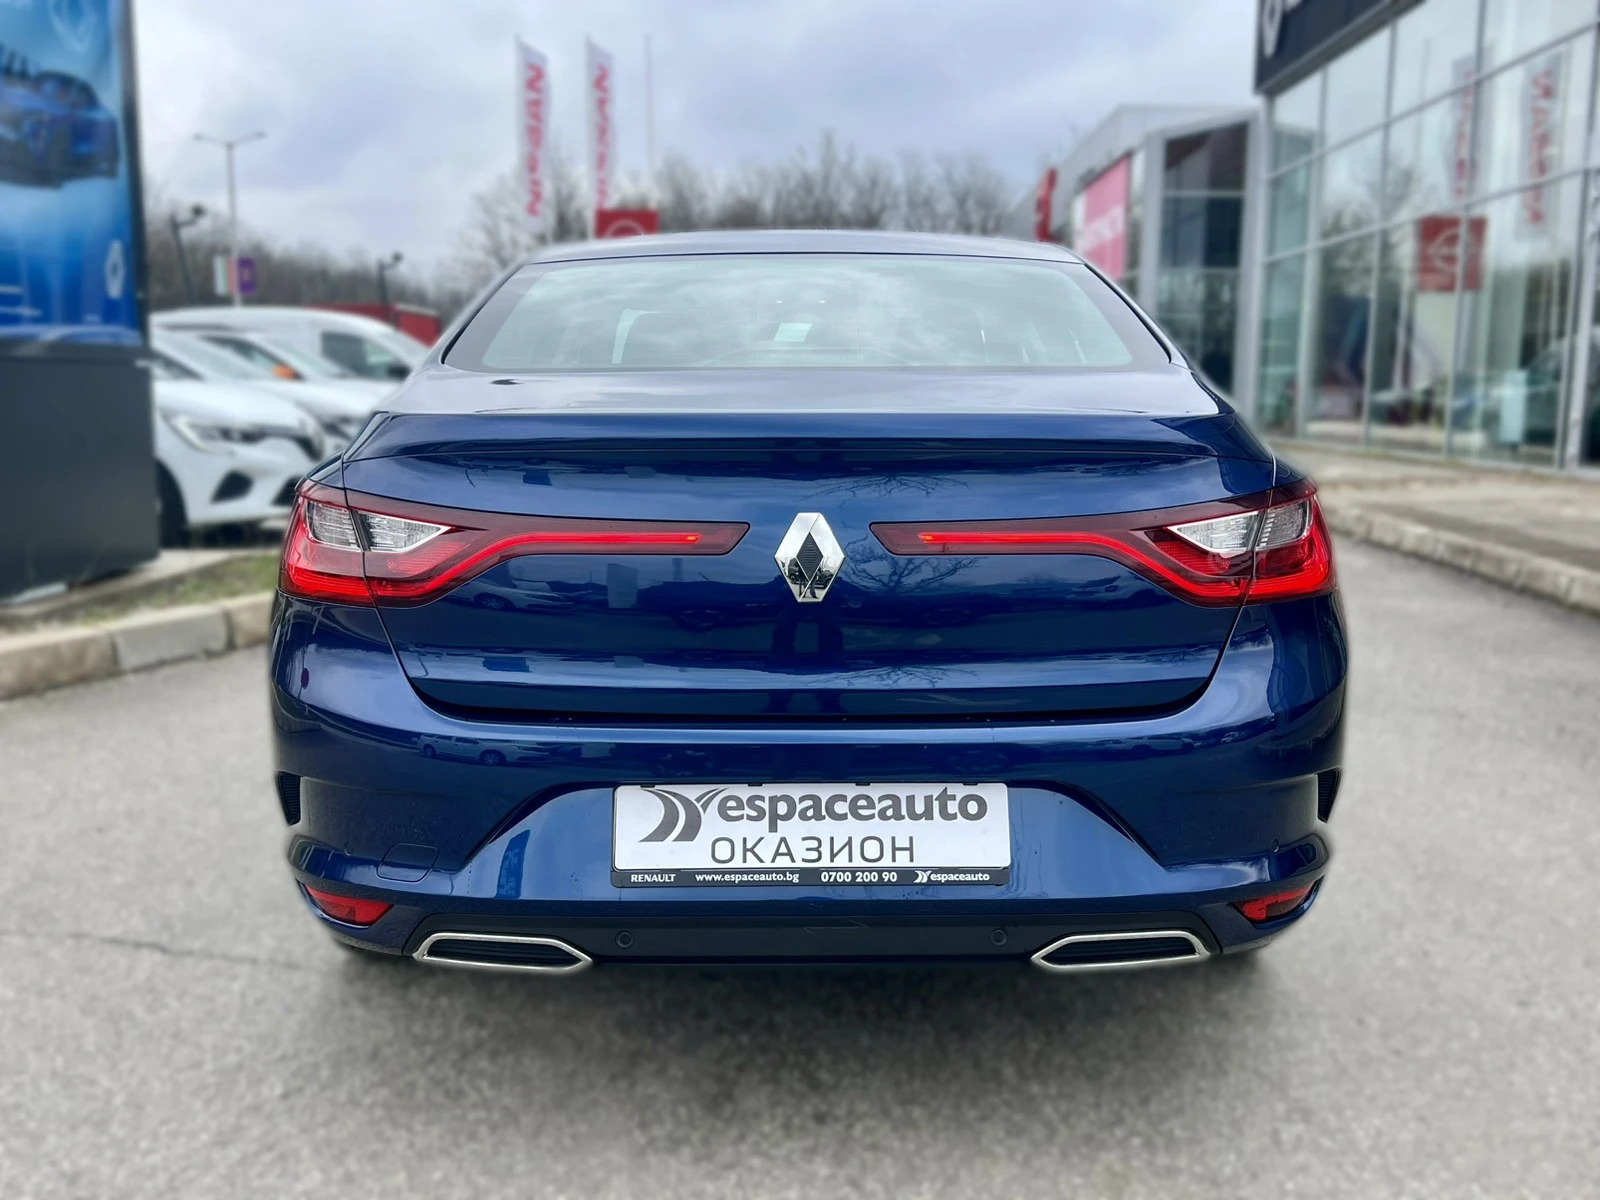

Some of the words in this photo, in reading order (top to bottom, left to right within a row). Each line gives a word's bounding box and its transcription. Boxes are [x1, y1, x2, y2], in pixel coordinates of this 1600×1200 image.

[717, 786, 988, 833] espaceauto
[710, 835, 915, 864] ОКАЗИОН
[630, 873, 676, 883] RENAULT
[695, 872, 800, 884] www.espaceauto.bg
[820, 871, 852, 882] 0700
[855, 871, 879, 882] 200
[882, 871, 898, 882] 90
[930, 872, 990, 883] espaceauto
